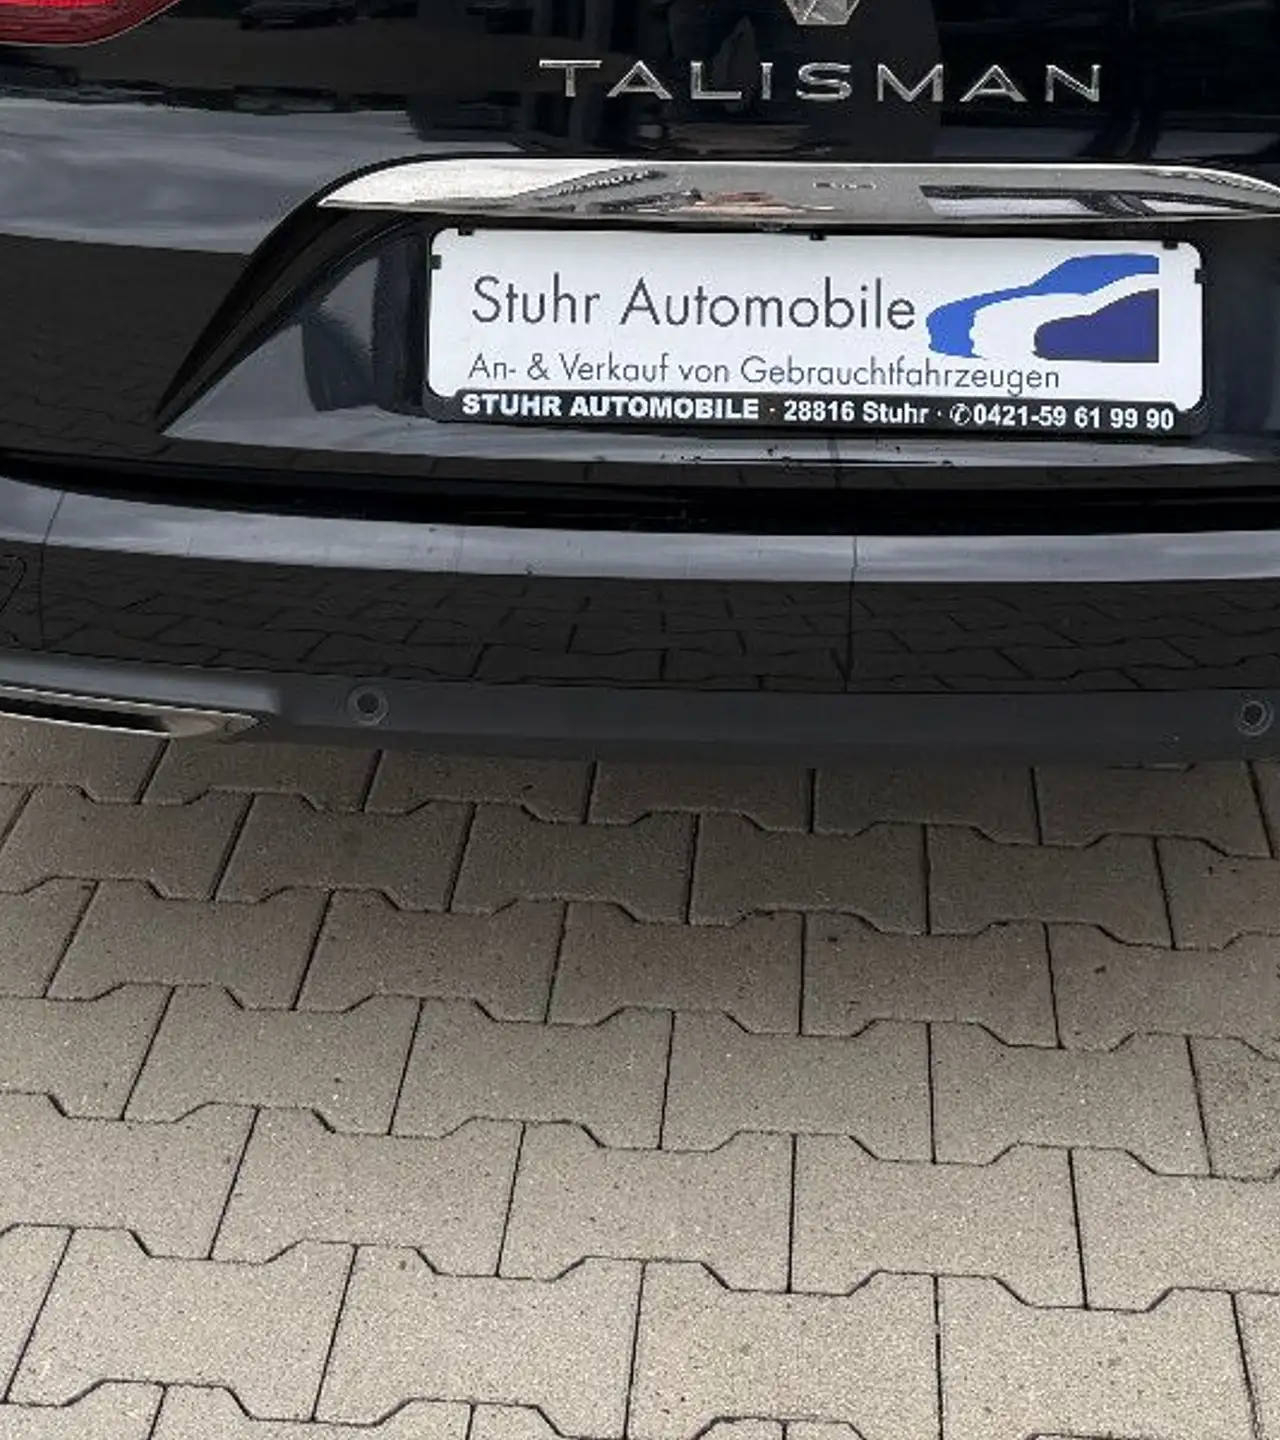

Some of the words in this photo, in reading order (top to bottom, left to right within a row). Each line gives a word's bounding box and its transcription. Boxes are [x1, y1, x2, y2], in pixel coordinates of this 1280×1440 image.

[539, 59, 1102, 103] TALISMAN
[472, 272, 600, 324] Stuhr
[619, 275, 916, 330] Automobile
[468, 352, 517, 381] An-
[526, 352, 550, 381] &
[559, 351, 670, 383] Verkauf
[678, 361, 730, 384] von
[740, 354, 1060, 398] Gebrauchtfahrzeugen
[462, 393, 562, 418] STUHR
[570, 396, 760, 421] AUTOMOBILE
[783, 399, 856, 422] 28816
[862, 400, 930, 424] Stuhr
[1074, 406, 1100, 429] 61
[1110, 407, 1138, 429] 99
[1146, 409, 1175, 431] 90
